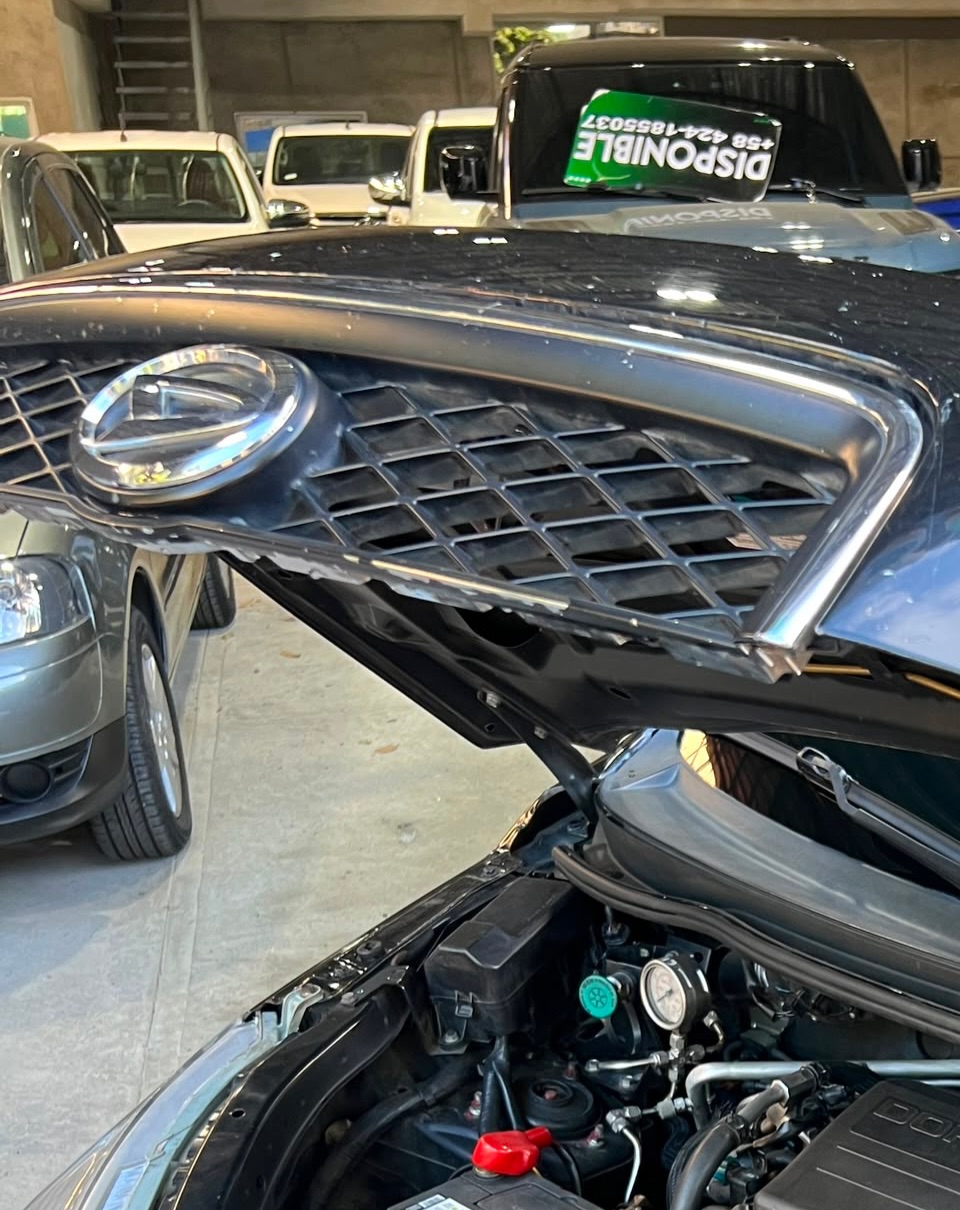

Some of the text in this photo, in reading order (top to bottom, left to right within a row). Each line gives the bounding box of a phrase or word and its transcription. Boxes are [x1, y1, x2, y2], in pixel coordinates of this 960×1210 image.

[580, 114, 775, 151] +58 424-1855037
[572, 130, 772, 181] DISPONIBLE
